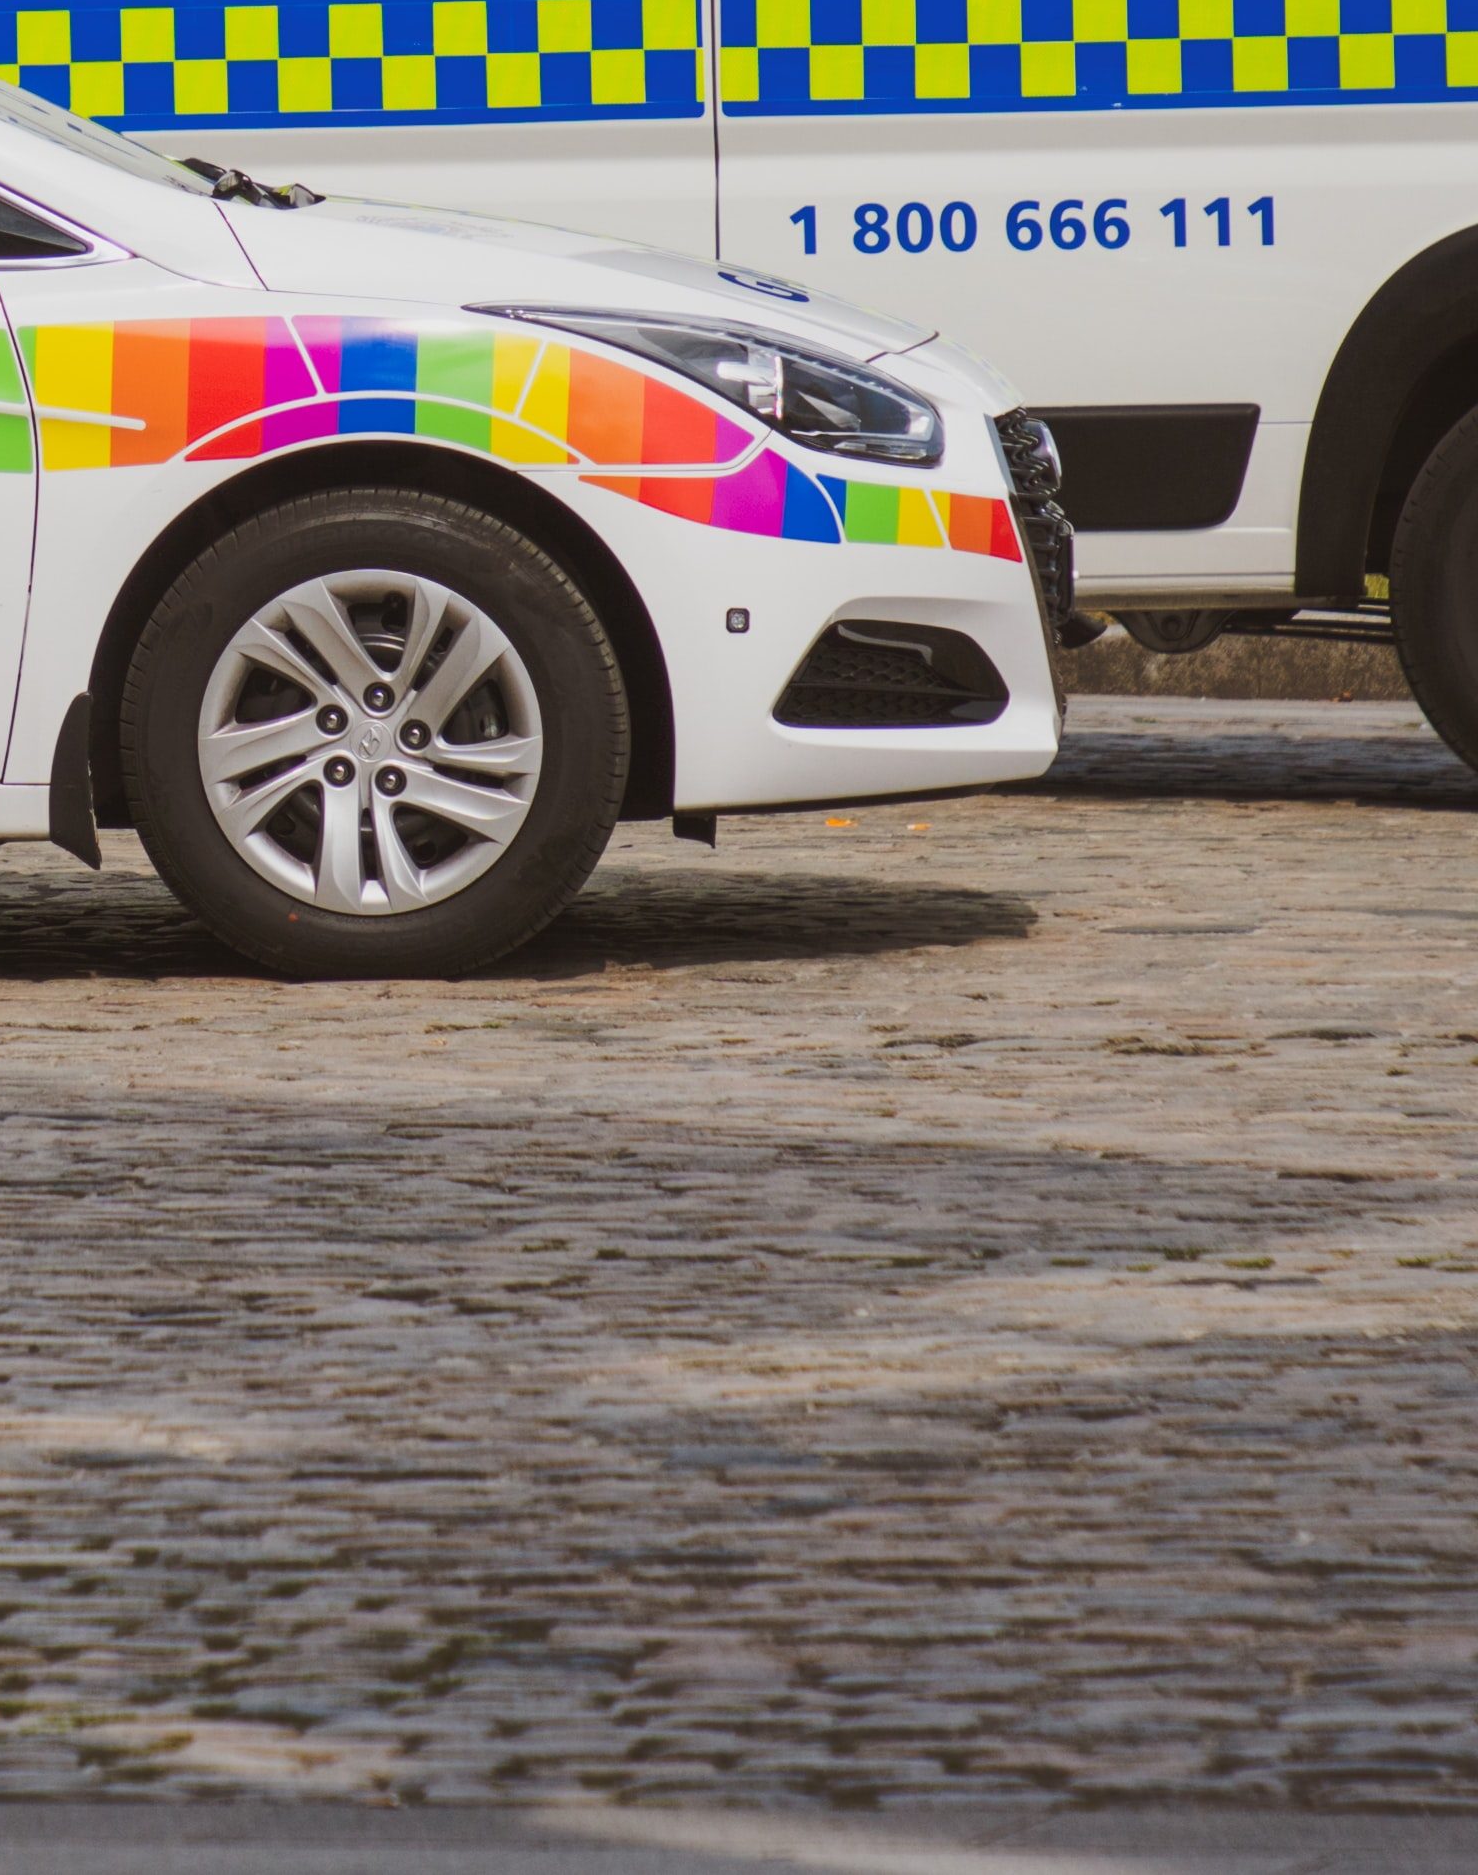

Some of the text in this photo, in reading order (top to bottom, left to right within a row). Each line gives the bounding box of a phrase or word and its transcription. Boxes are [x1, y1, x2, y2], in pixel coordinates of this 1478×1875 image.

[789, 196, 1275, 255] 1 800 666 111
